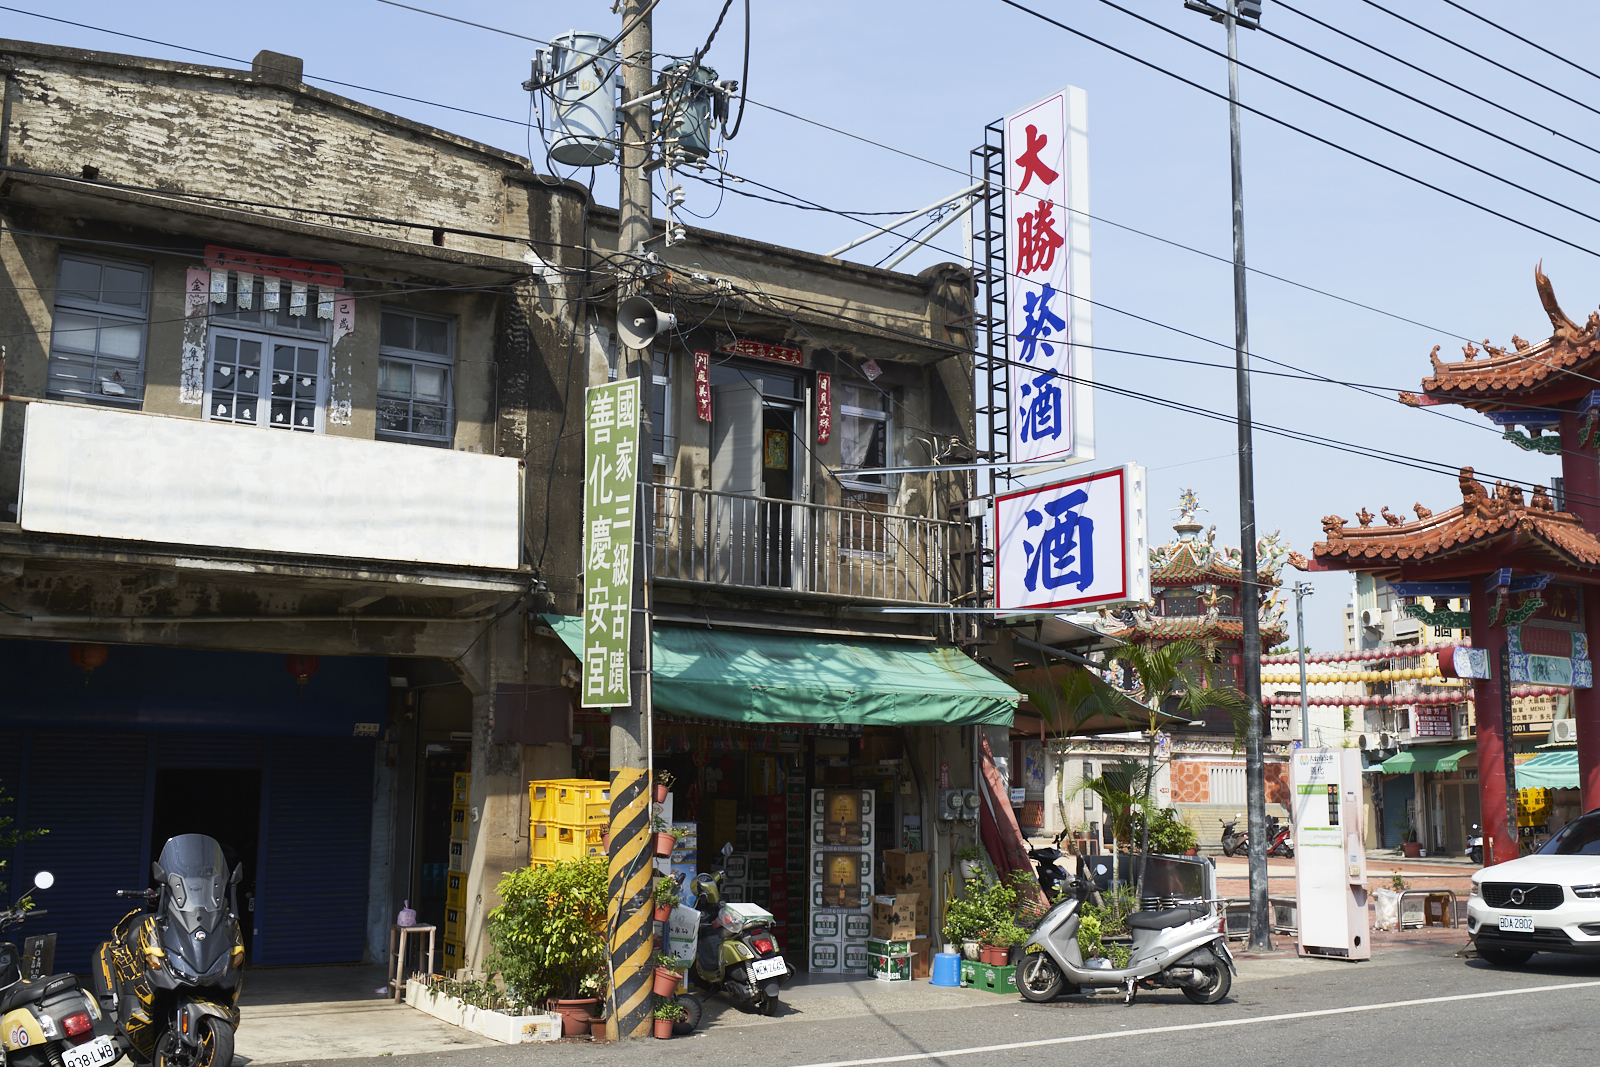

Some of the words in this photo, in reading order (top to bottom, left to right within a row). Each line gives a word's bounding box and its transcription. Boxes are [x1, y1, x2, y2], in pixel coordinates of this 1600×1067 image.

[1014, 123, 1066, 443] 大勝菸酒
[586, 391, 616, 698] 善化慶安宮
[606, 383, 636, 696] 國家三級古蹟
[1023, 489, 1094, 593] 酒
